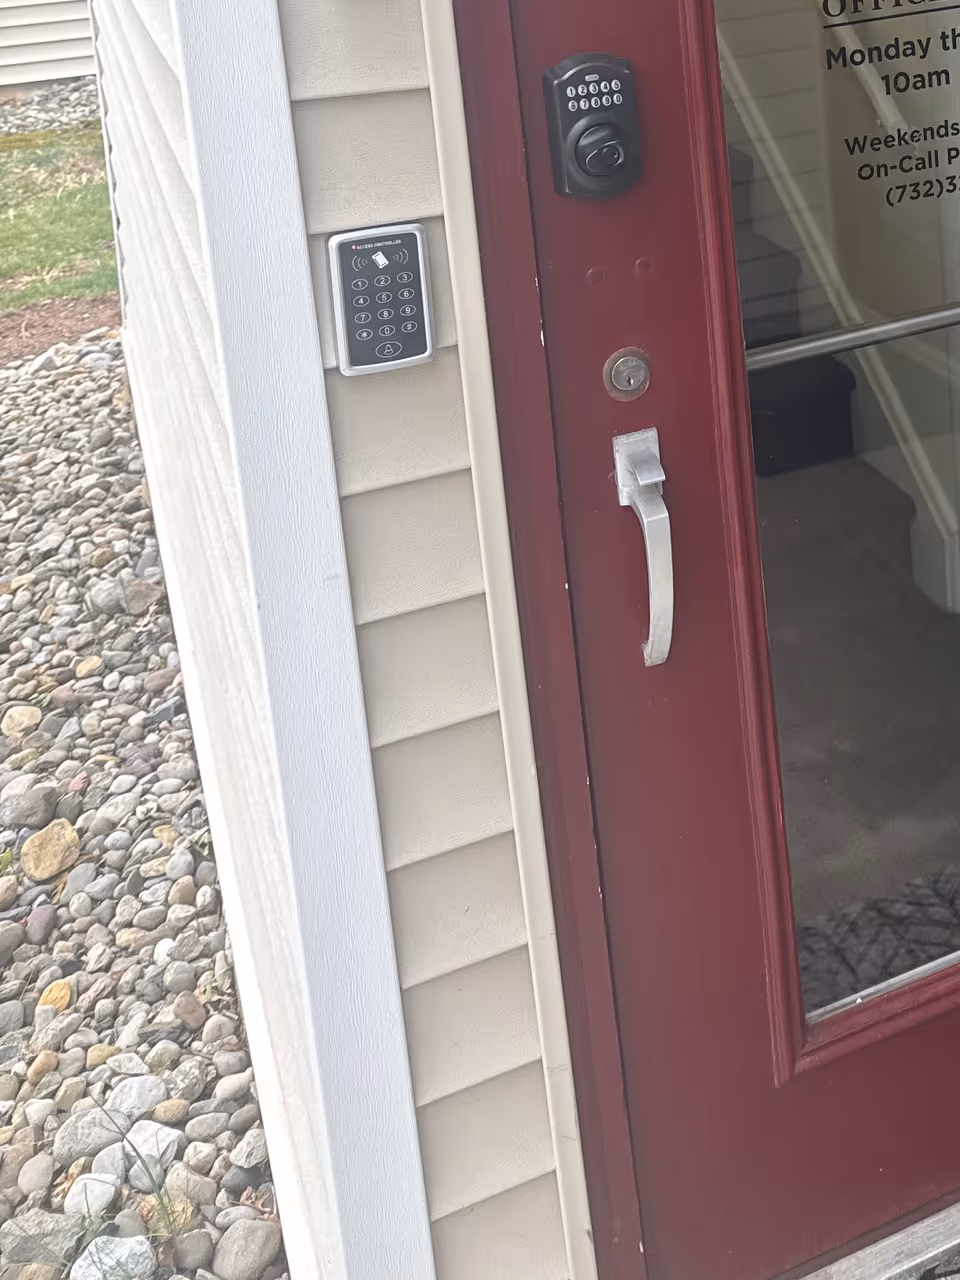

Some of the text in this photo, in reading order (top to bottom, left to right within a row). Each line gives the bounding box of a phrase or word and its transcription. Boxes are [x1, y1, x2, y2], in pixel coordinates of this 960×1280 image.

[825, 36, 931, 70] Monday
[881, 70, 951, 96] 10am
[844, 121, 960, 156] Weekends
[857, 149, 940, 181] On-Call
